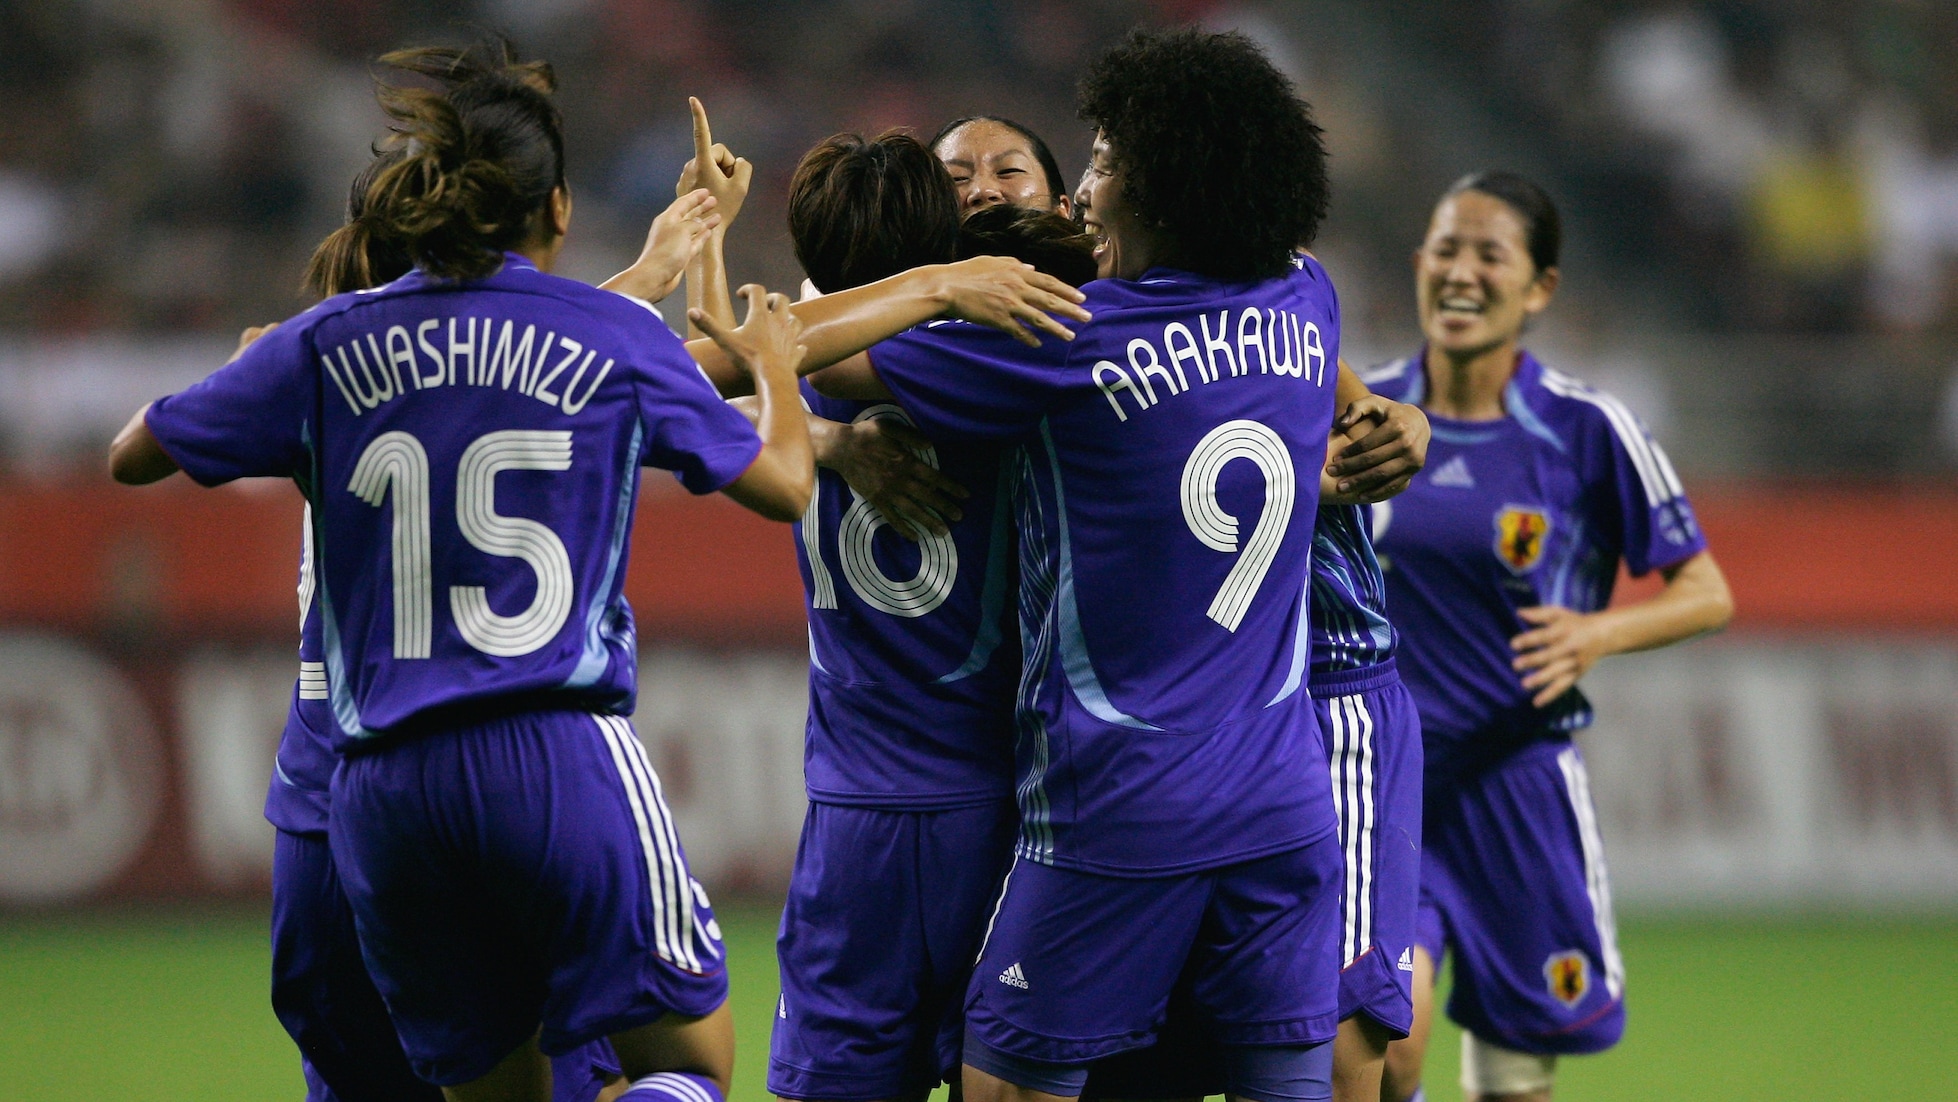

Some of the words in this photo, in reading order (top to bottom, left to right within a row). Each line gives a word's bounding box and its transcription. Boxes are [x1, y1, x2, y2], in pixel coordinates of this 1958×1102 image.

[322, 317, 615, 416] IWASHIMIZU
[1092, 306, 1325, 422] ARAKAWA
[347, 429, 574, 659] 15
[1180, 419, 1296, 633] 9
[999, 974, 1029, 989] adidas
